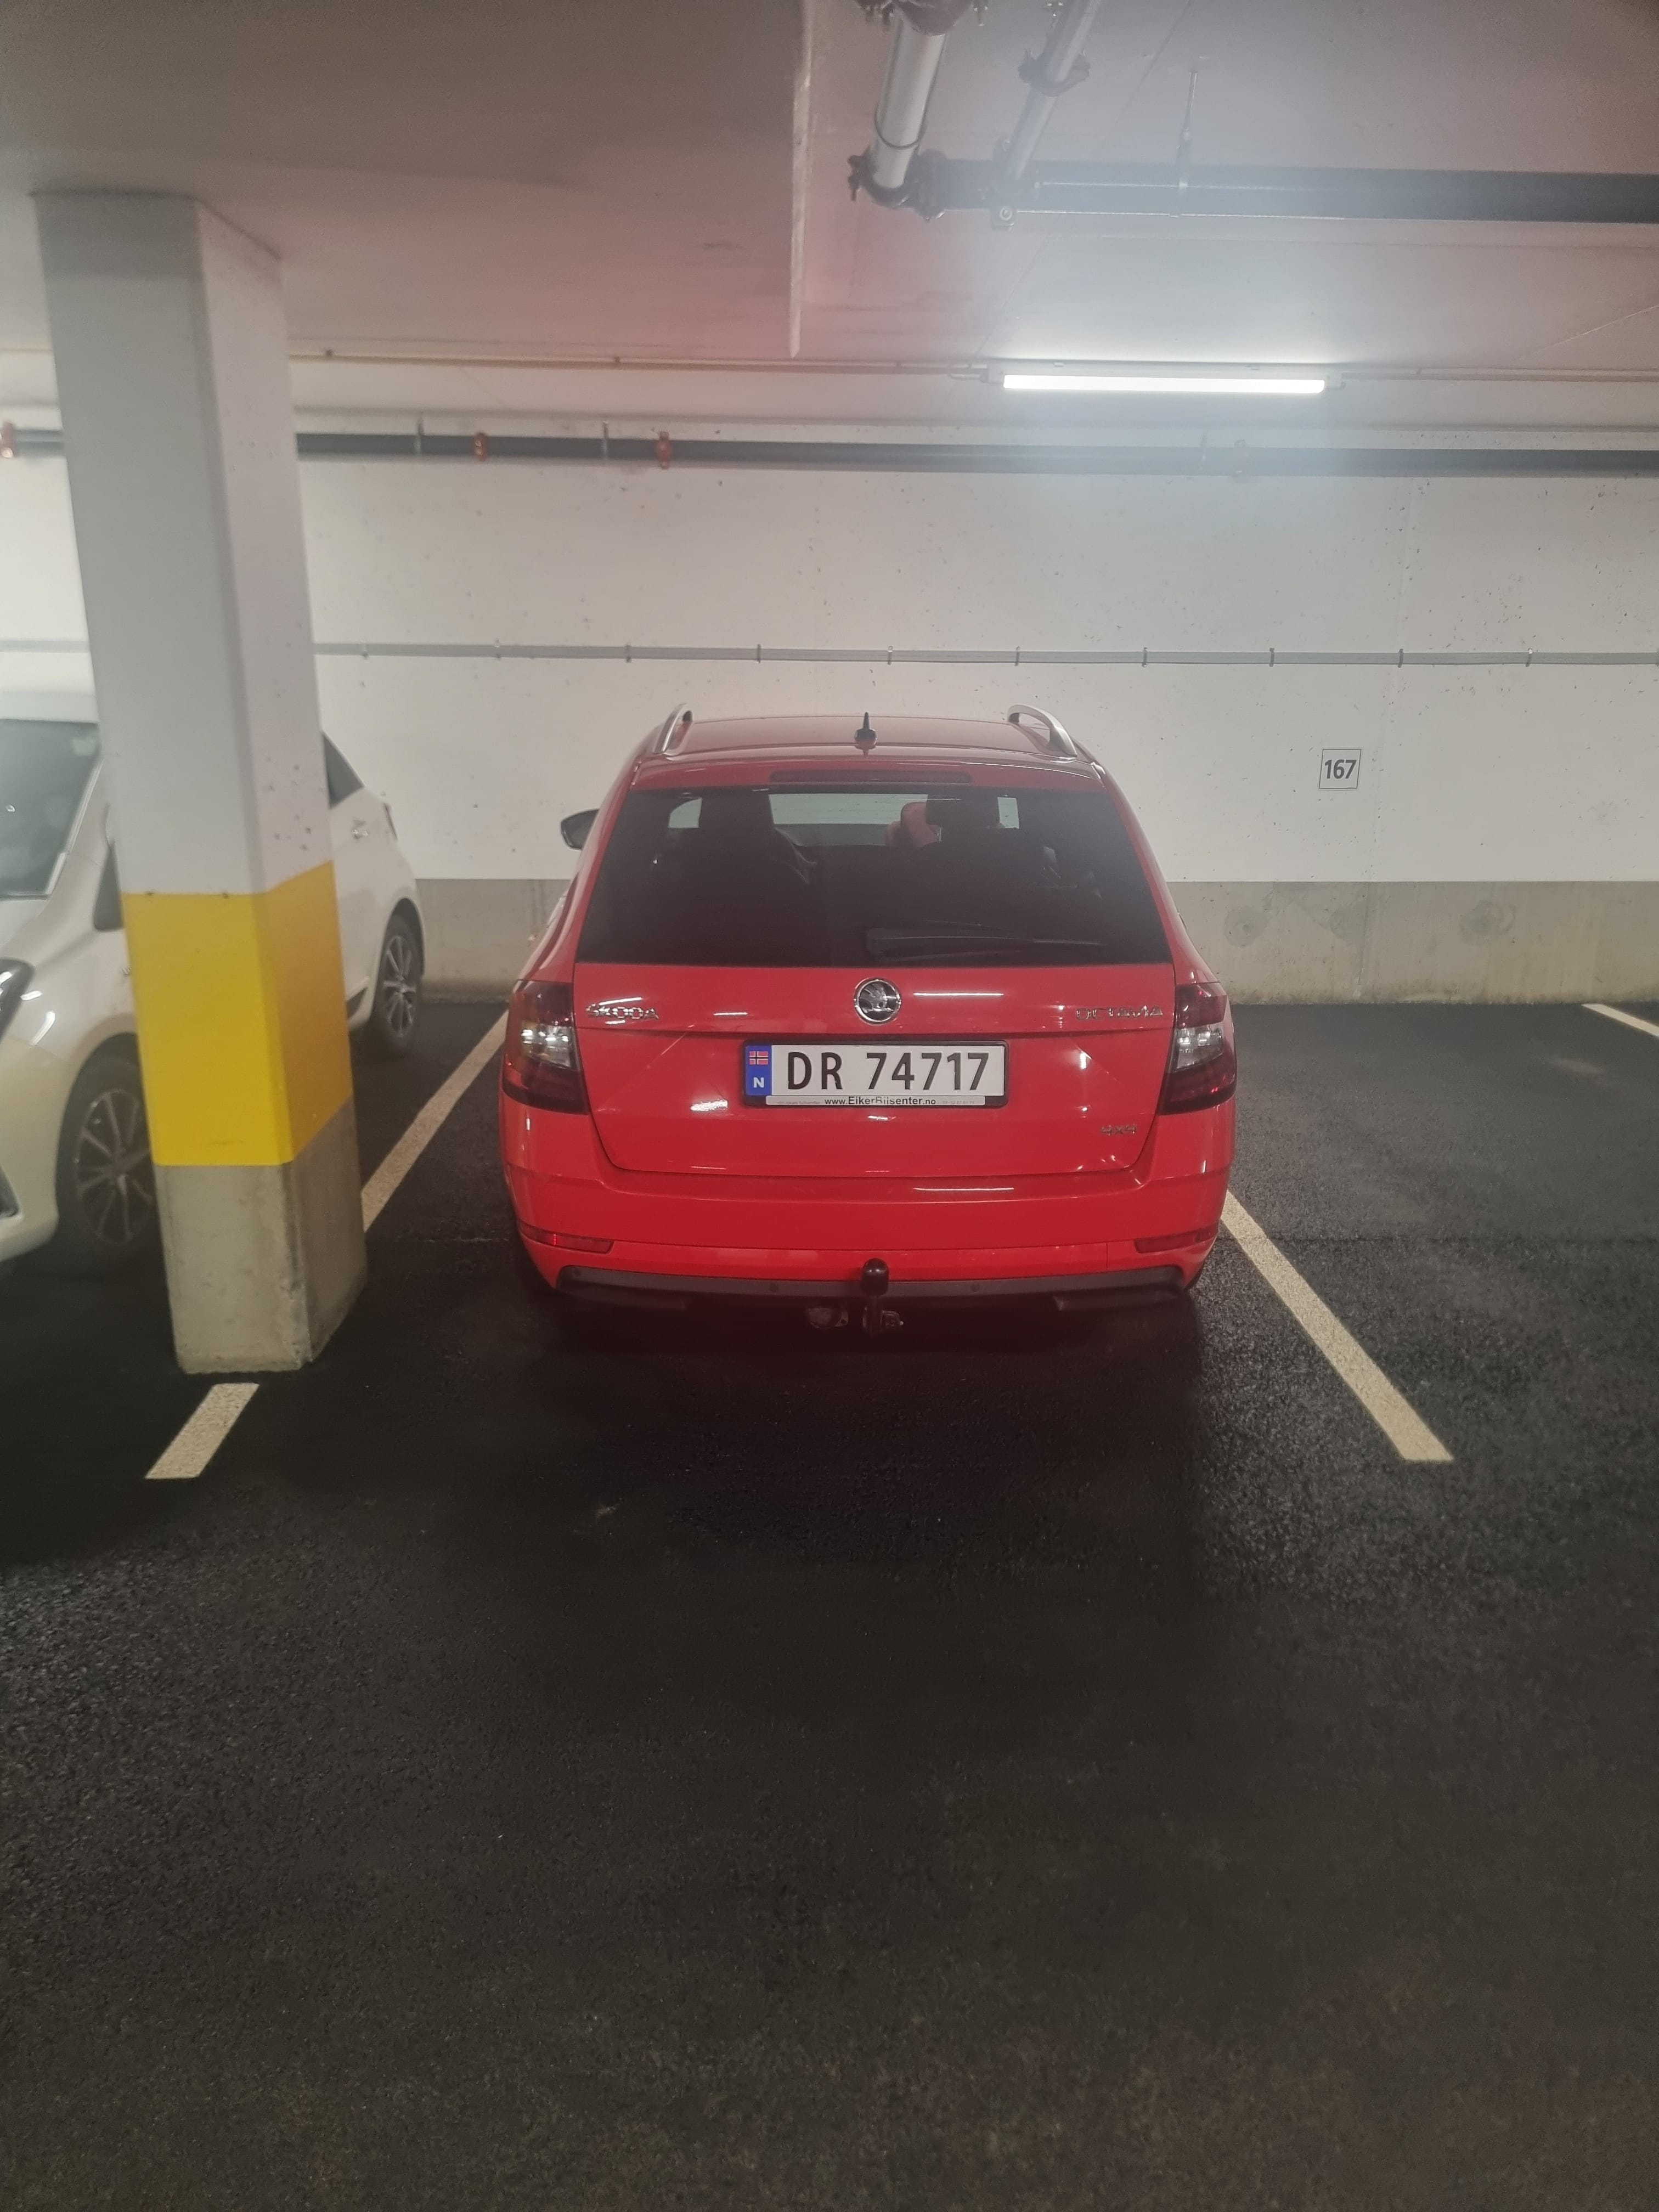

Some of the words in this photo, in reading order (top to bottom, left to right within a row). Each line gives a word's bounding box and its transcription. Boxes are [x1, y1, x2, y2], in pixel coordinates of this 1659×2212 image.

[1324, 759, 1357, 779] 167
[788, 1052, 843, 1090] DR
[866, 1052, 989, 1090] 74717
[753, 1077, 765, 1088] N
